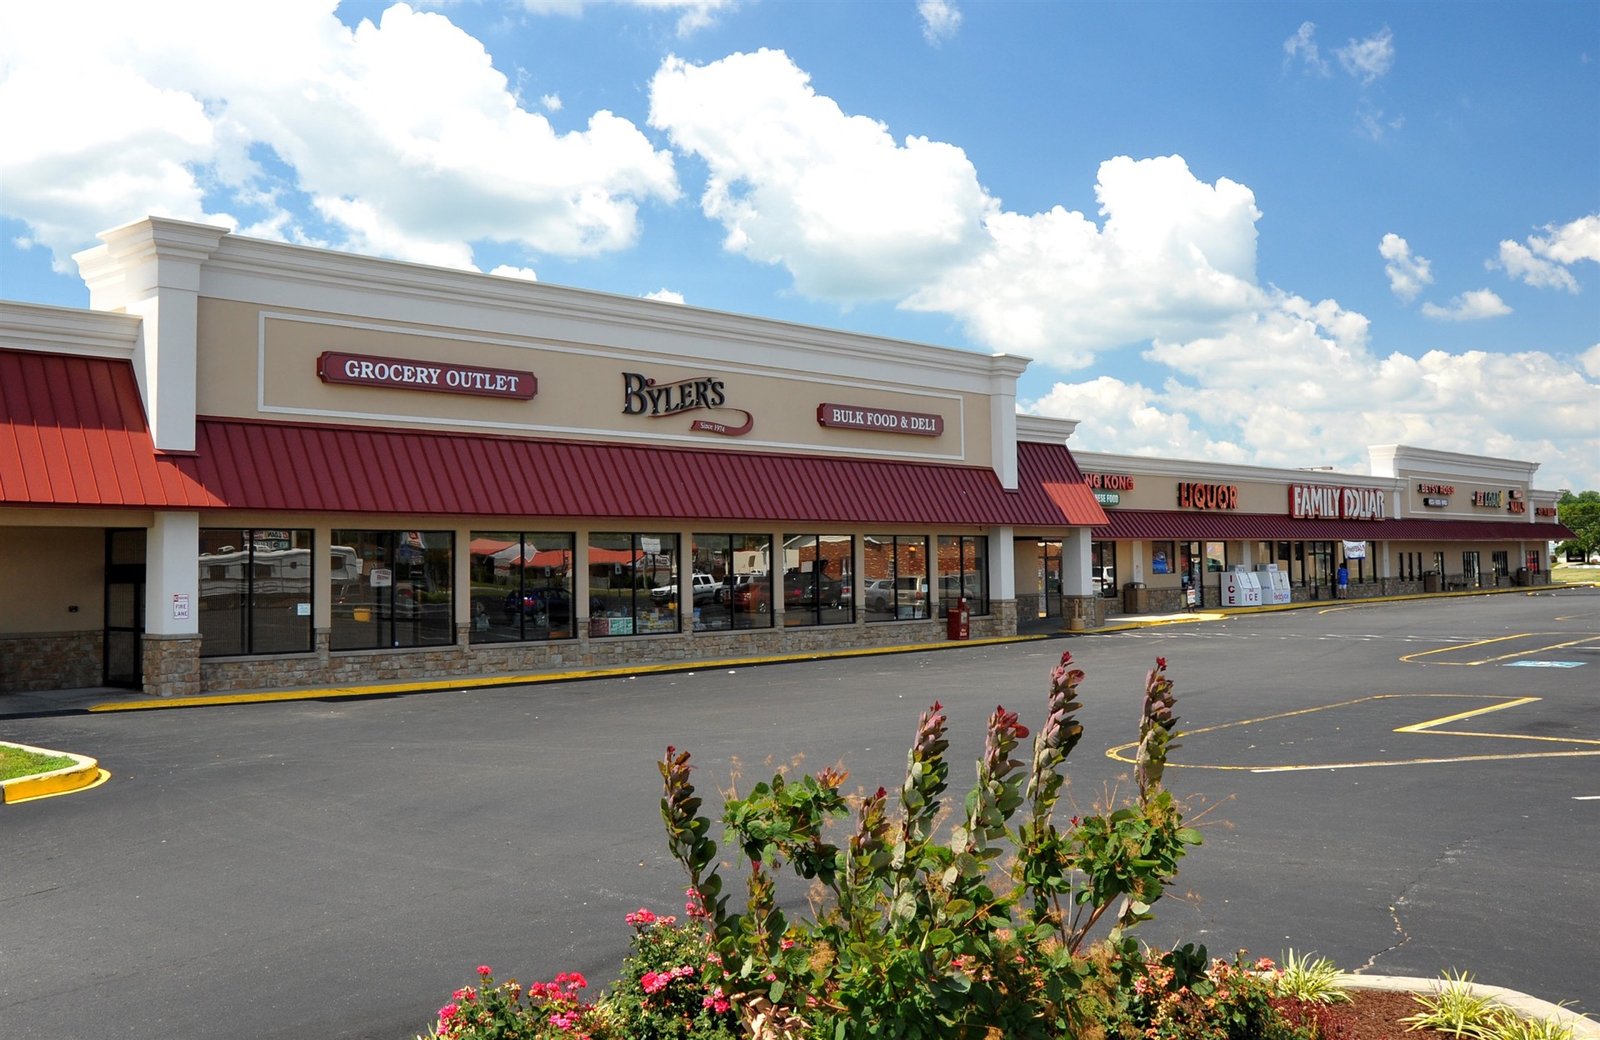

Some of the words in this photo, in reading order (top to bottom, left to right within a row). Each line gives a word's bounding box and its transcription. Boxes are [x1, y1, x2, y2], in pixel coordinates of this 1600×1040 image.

[344, 360, 441, 385] GROCERY
[446, 370, 519, 392] OUTLET
[621, 372, 725, 415] BYLER'S
[700, 422, 714, 430] Since
[714, 424, 725, 432] 1974
[832, 409, 864, 424] BULK
[867, 412, 897, 427] FOOD
[900, 416, 908, 429] &
[911, 417, 936, 431] DELI
[1083, 473, 1102, 488] NG
[1103, 474, 1134, 490] KONG
[1106, 494, 1119, 503] FOOD
[1178, 482, 1238, 510] LIQUOR
[1292, 485, 1340, 517] FAMILY
[1343, 487, 1385, 519] DOLLAR
[1245, 593, 1258, 601] ICE
